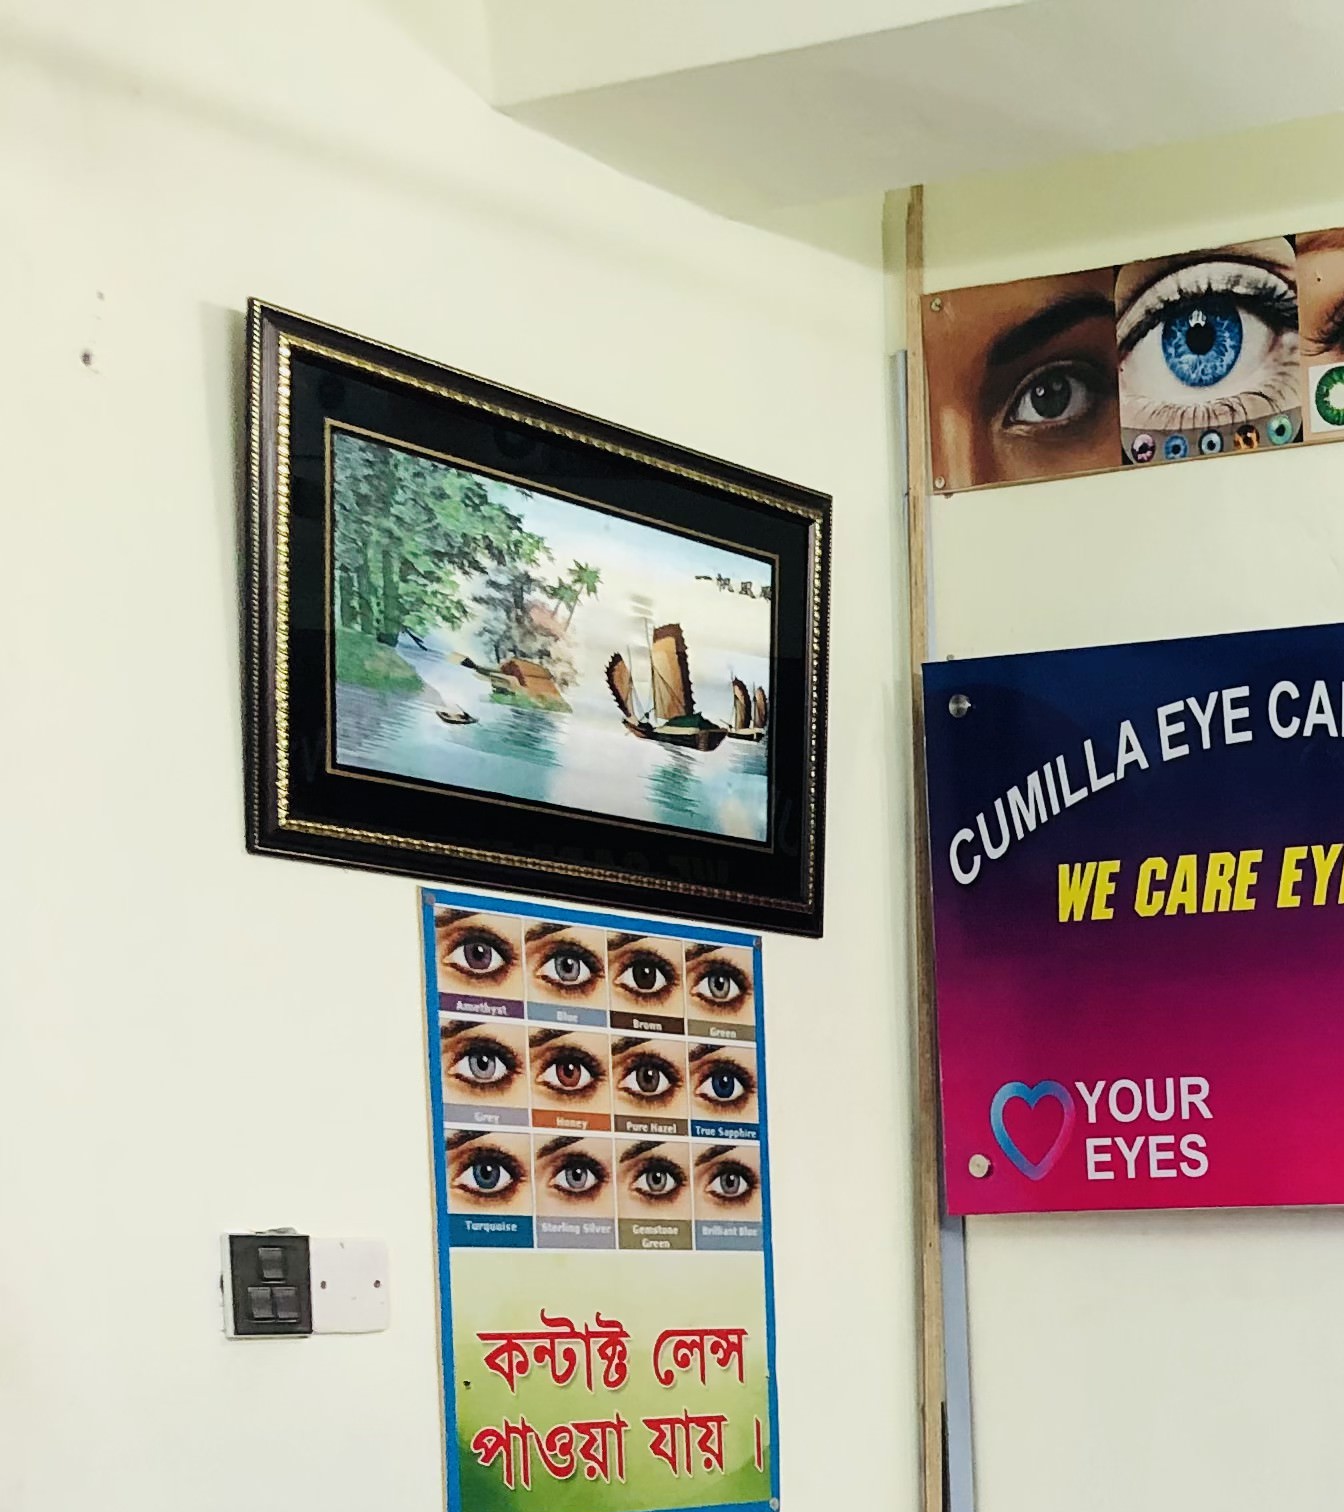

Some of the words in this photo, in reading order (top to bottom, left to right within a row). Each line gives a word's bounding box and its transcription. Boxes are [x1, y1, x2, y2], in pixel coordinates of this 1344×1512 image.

[948, 720, 1150, 885] CUMILLA
[1157, 686, 1254, 762] EYE
[1057, 860, 1121, 923] WE
[1134, 849, 1263, 917] CARE
[632, 1018, 663, 1031] Brown
[709, 1027, 737, 1039] Green
[1074, 1076, 1213, 1124] YOUR
[626, 1121, 648, 1131] Pure
[650, 1122, 677, 1134] Hazel
[695, 1125, 716, 1136] True
[718, 1126, 757, 1139] Sapphire
[1085, 1133, 1210, 1180] EYES
[464, 1220, 518, 1233] Turquoise
[632, 1224, 679, 1236] Gemstone
[641, 1239, 671, 1249] Green
[652, 1327, 749, 1388] লেন্স
[470, 1411, 630, 1491] পাওয়া
